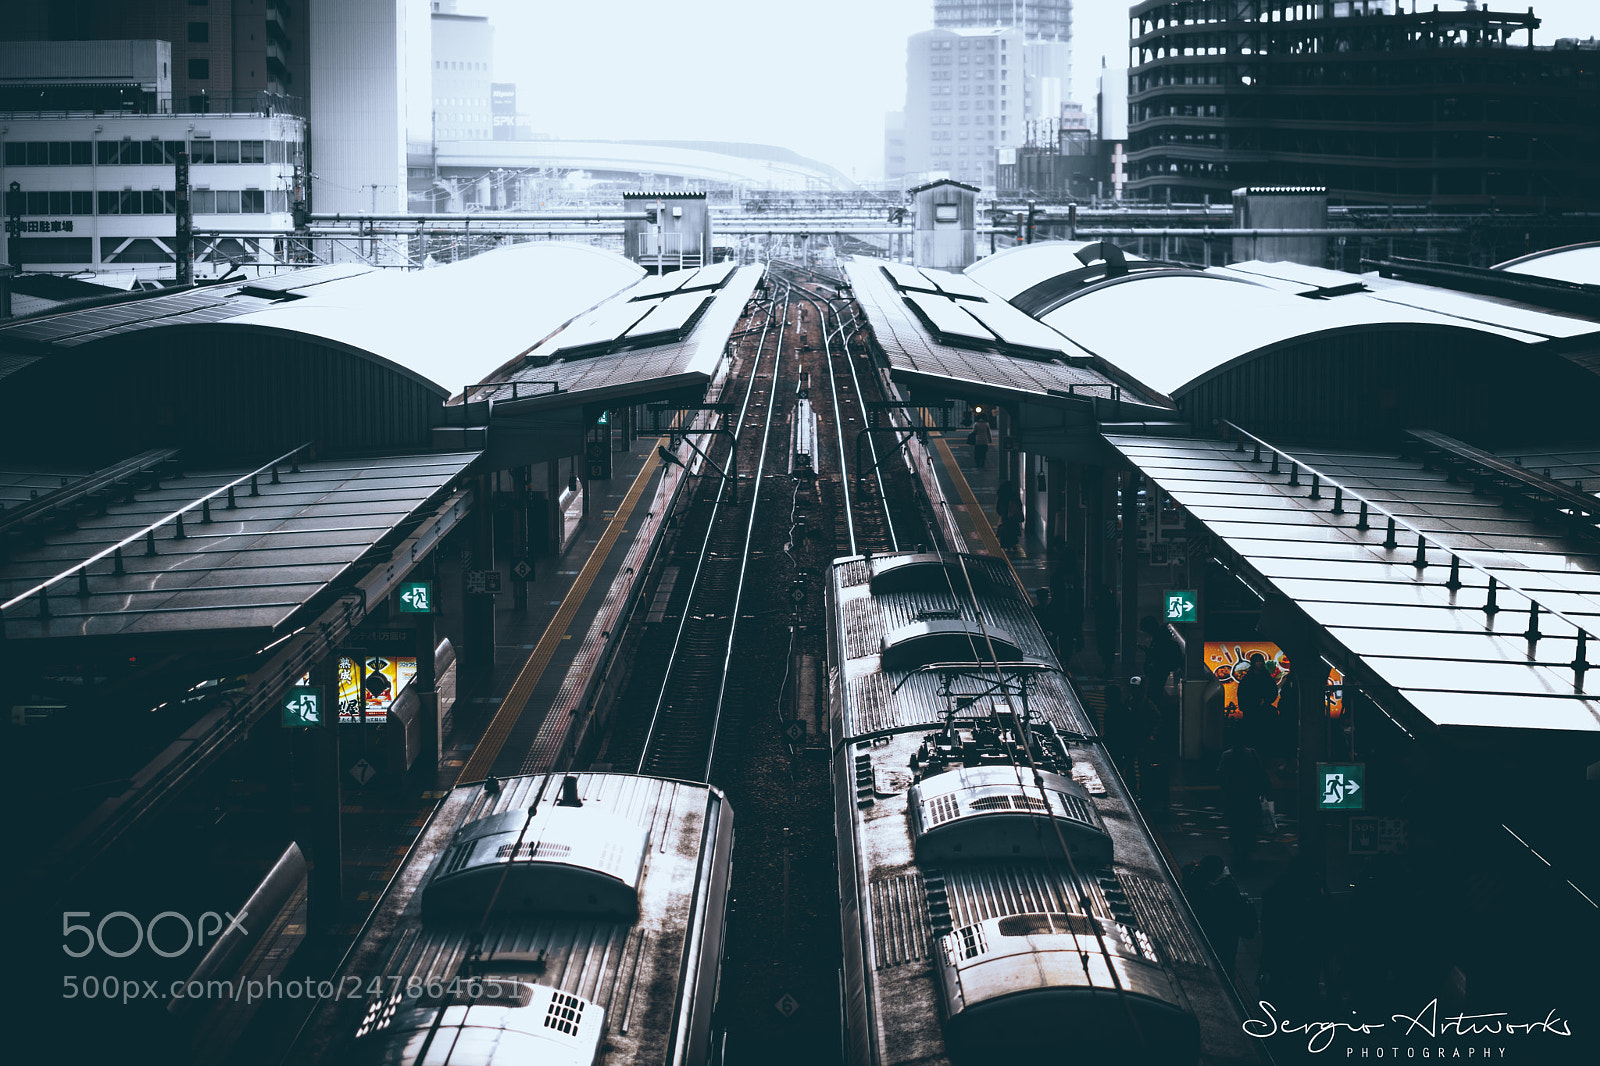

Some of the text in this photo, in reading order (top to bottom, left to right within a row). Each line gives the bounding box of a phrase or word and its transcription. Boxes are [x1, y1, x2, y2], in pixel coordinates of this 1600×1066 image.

[519, 565, 526, 575] 8
[791, 726, 799, 737] 8
[357, 763, 368, 782] 7
[1354, 822, 1376, 832] SOS
[782, 996, 792, 1014] 6
